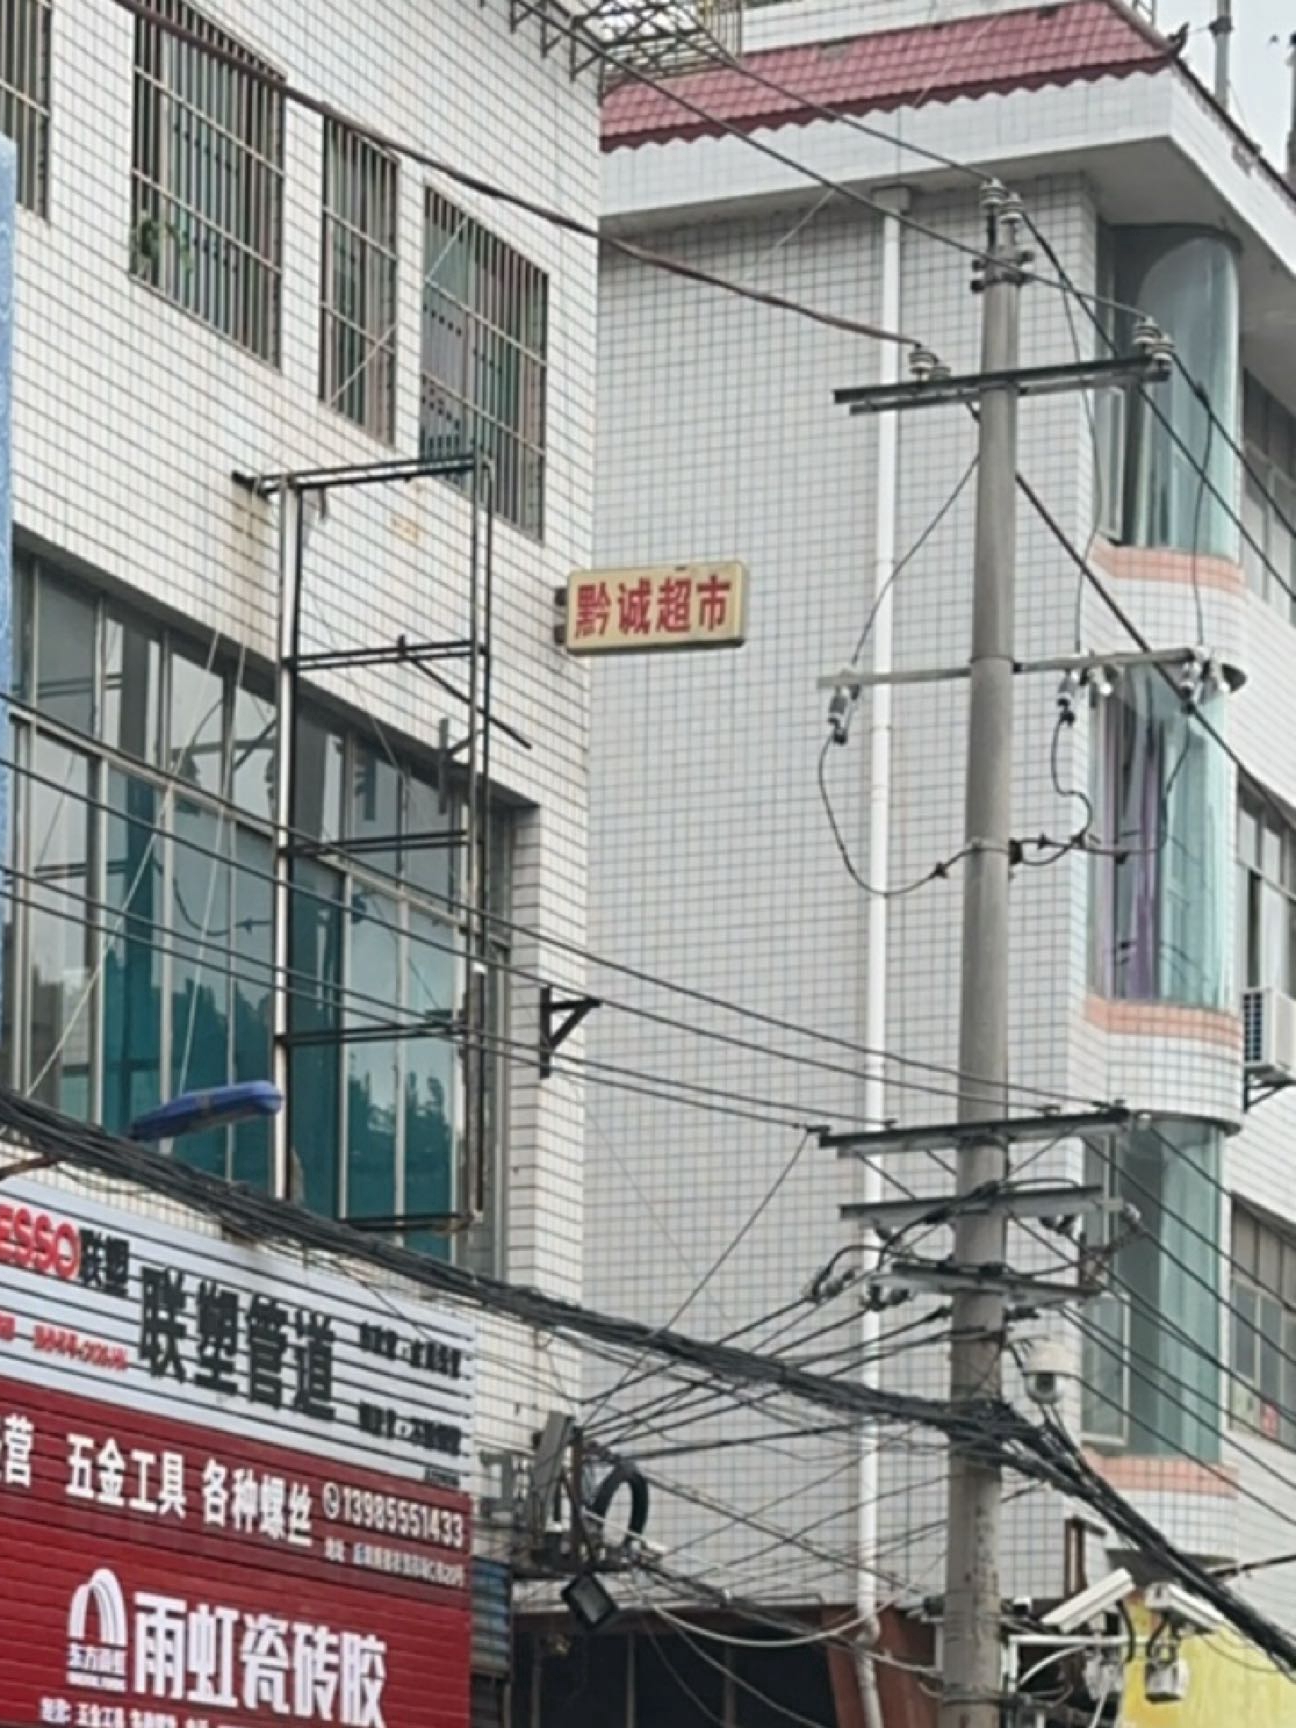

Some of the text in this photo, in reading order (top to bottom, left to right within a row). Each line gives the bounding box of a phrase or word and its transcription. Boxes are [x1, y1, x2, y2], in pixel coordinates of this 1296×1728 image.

[576, 575, 732, 638] 黔诚超市
[137, 1265, 337, 1420] 联塑管道
[66, 1432, 188, 1521] 五金工具
[201, 1457, 314, 1549] 各种螺丝
